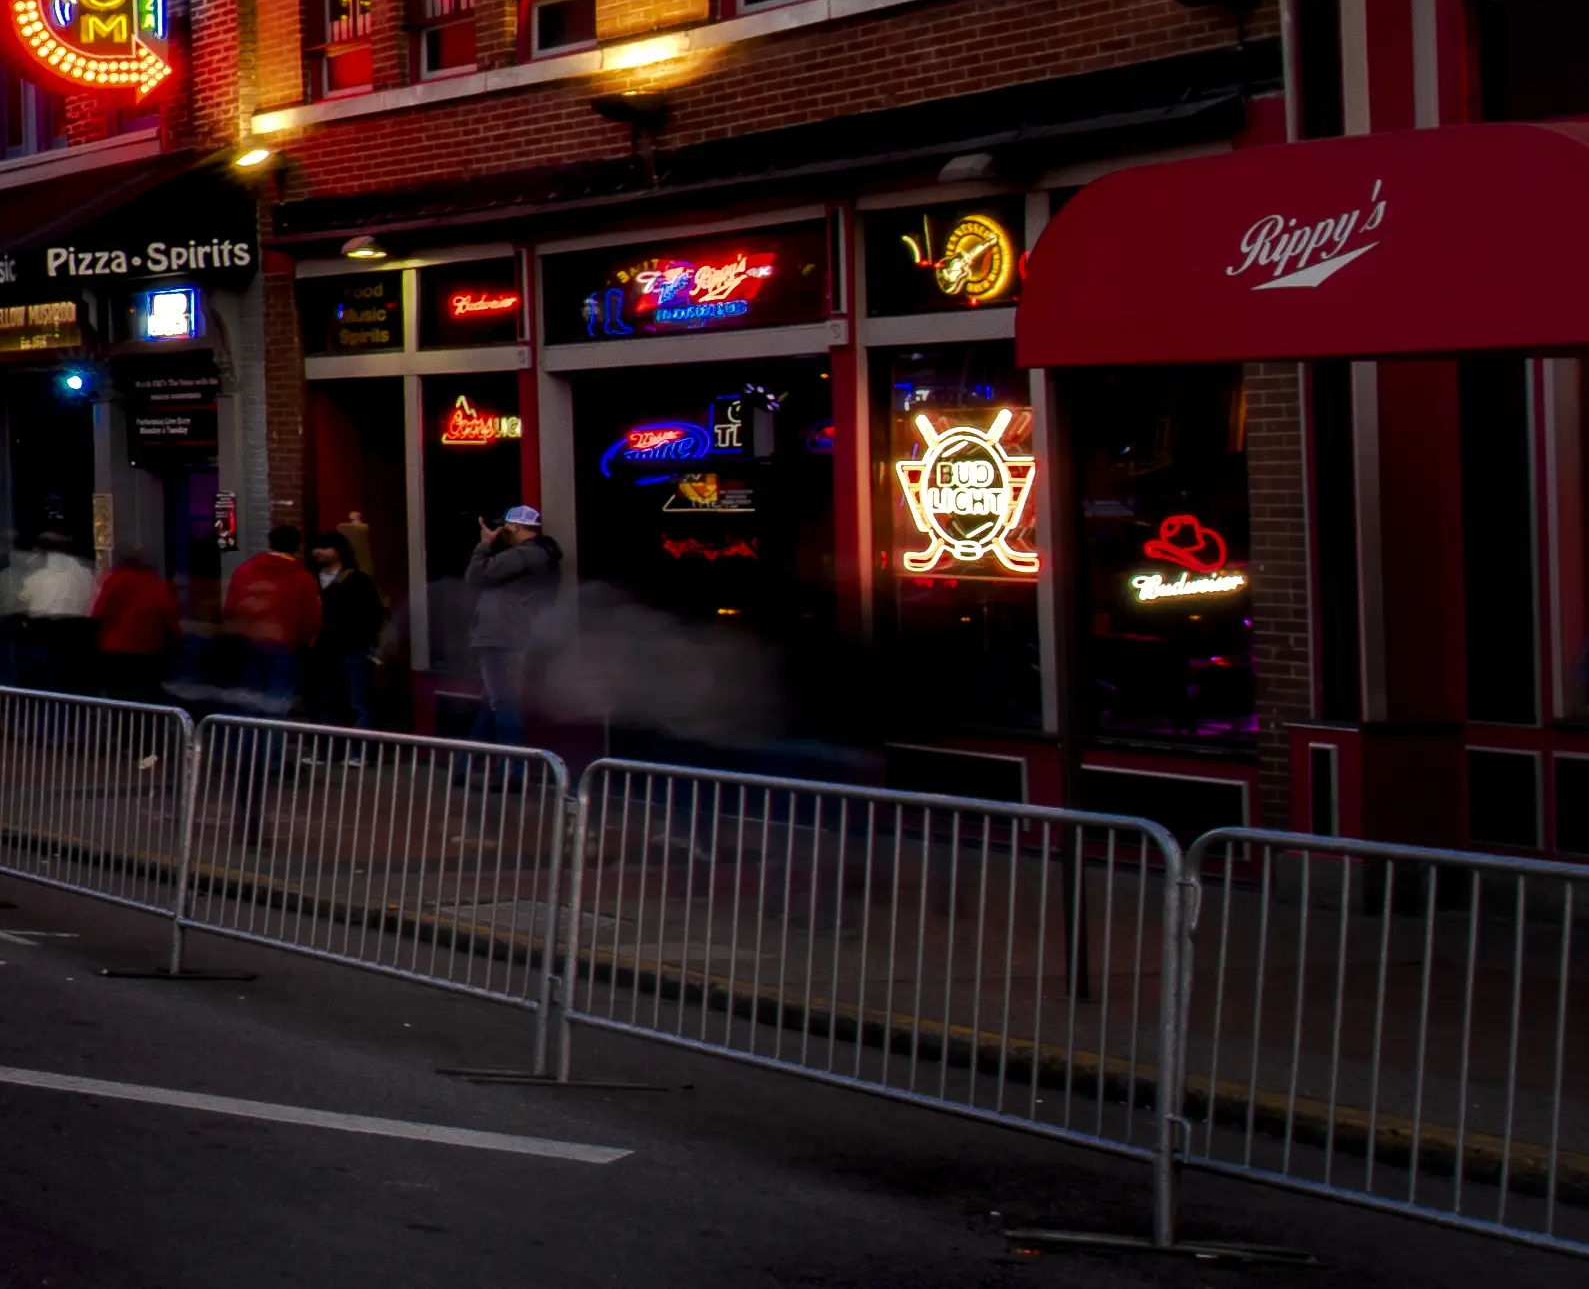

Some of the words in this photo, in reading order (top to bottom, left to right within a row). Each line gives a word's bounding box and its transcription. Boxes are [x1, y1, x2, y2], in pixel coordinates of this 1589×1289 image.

[1226, 179, 1387, 276] Rippy's
[47, 246, 128, 277] Pizza
[147, 238, 252, 272] Spirits
[338, 327, 390, 346] Spirits
[936, 460, 995, 488] BUD
[929, 487, 1003, 516] LIGHT
[1132, 573, 1245, 602] Budweiser
